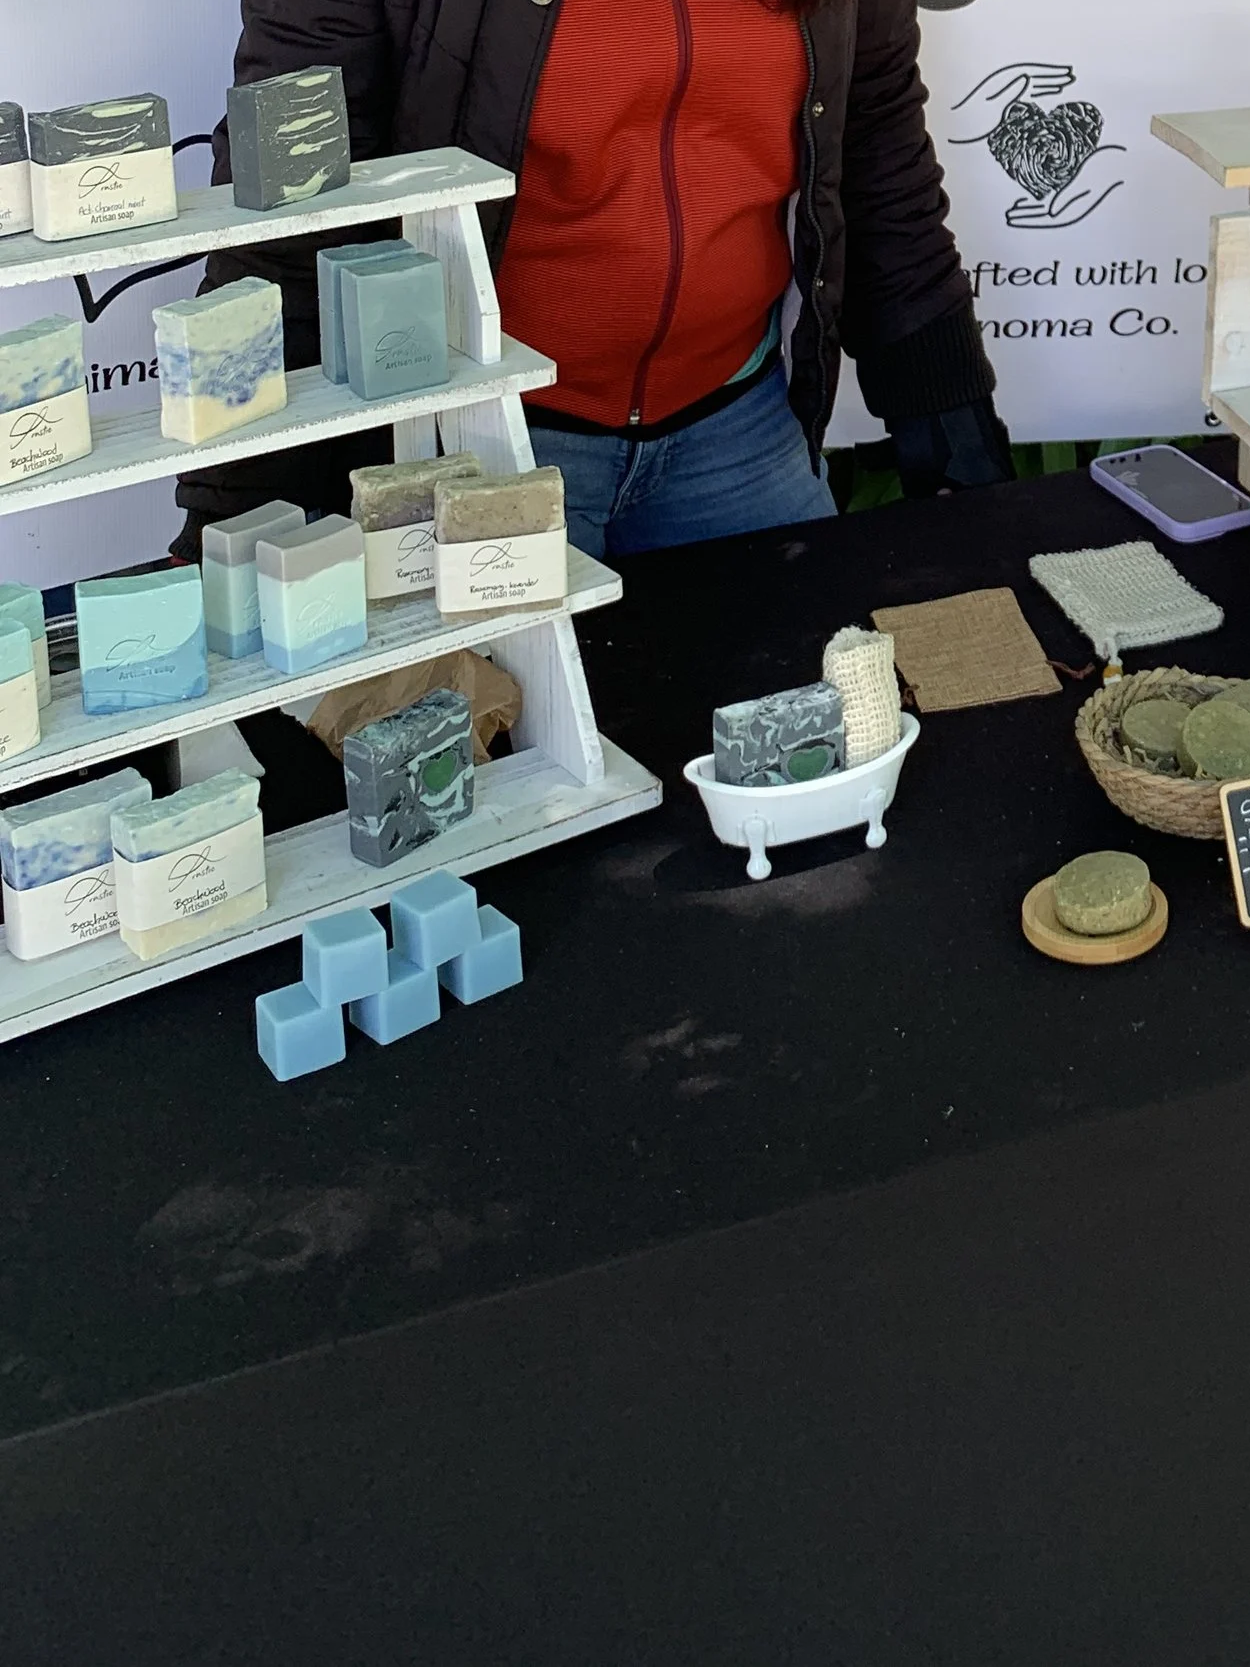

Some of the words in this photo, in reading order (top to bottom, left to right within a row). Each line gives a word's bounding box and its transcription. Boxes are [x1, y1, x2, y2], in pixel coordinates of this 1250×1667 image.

[90, 214, 116, 224] Artisan
[118, 211, 134, 220] soap
[1075, 259, 1158, 286] with
[1173, 257, 1208, 284] lo
[978, 318, 1093, 339] noma
[1109, 307, 1178, 337] Co.
[23, 458, 47, 473] Artisan
[48, 454, 64, 466] soap
[482, 591, 508, 601] Artisan
[508, 589, 526, 598] soap
[182, 899, 210, 915] Artisan
[211, 891, 228, 905] soap
[80, 923, 107, 939] Artisan
